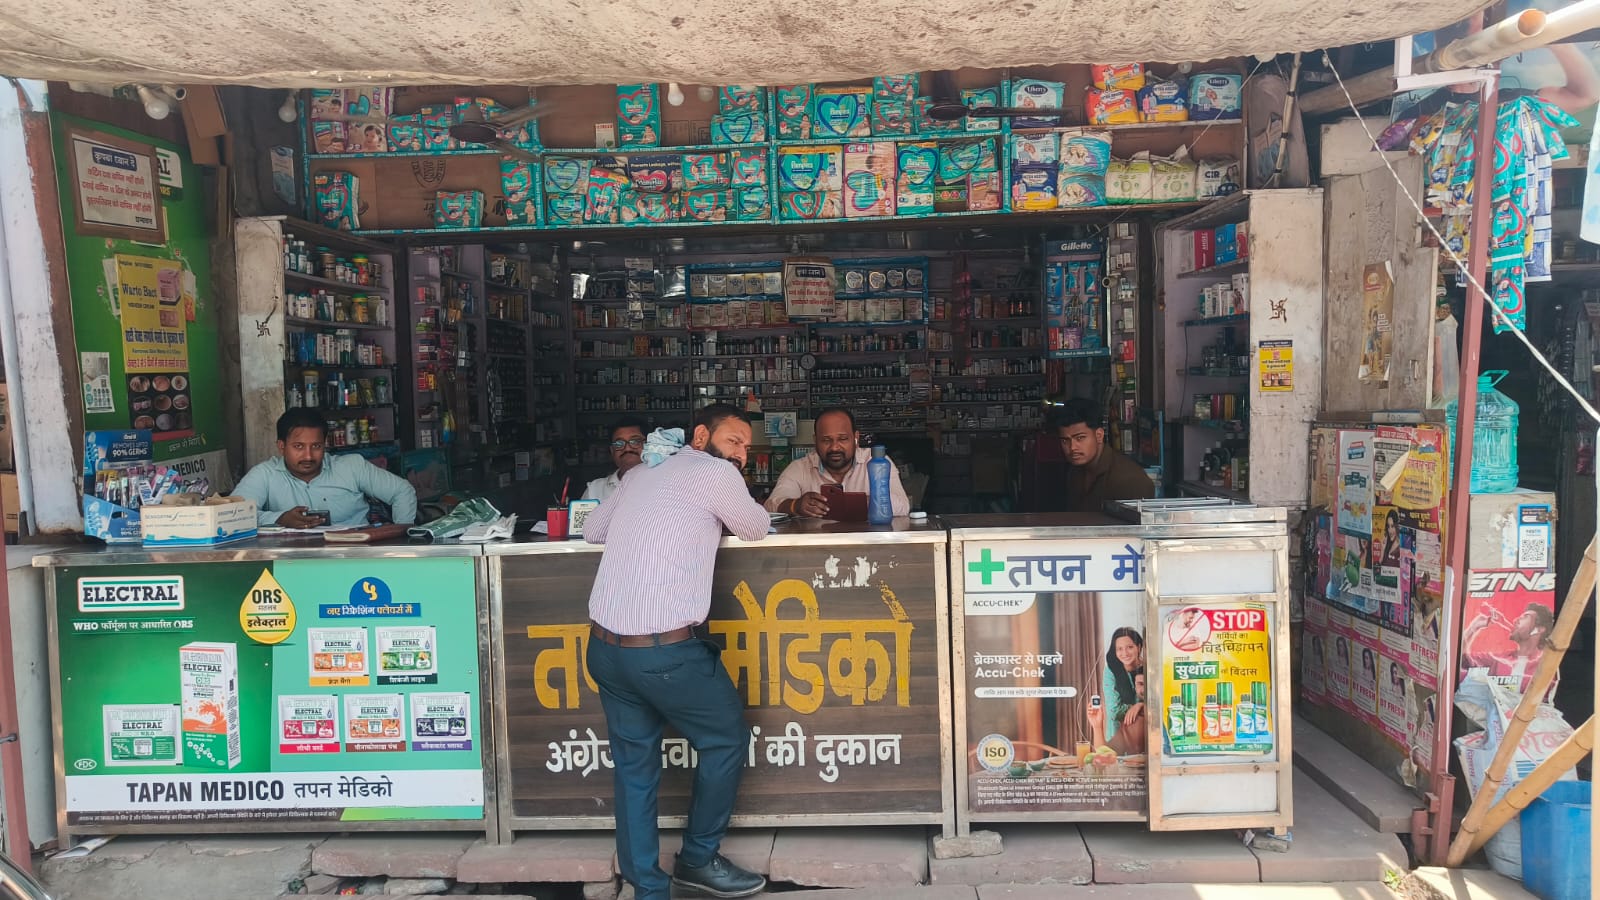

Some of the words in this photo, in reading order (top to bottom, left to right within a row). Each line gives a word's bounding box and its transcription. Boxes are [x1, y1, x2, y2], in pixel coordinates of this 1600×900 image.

[1061, 242, 1092, 251] Gillette
[1007, 555, 1092, 588] तपन
[1468, 572, 1556, 591] STING
[82, 585, 179, 603] ELECTRAL
[252, 588, 282, 605] ORS
[326, 607, 341, 615] नए
[73, 620, 99, 631] WHO
[129, 621, 139, 630] पर
[141, 619, 172, 630] आधारित
[174, 618, 194, 630] ORS
[1213, 611, 1261, 630] STOP
[973, 654, 1021, 666] ब्रेकफास्ट
[1024, 652, 1034, 664] से
[1036, 651, 1063, 665] पहले
[184, 664, 221, 672] ELECTRAL
[974, 667, 1046, 678] Accu-Chek
[1175, 662, 1217, 680] सुथॉल
[766, 722, 805, 767] की
[814, 733, 901, 783] दुकान
[985, 747, 1007, 758] ISO
[78, 761, 93, 769] FDC
[127, 782, 192, 802] TAPAN
[200, 780, 285, 801] MEDICO
[293, 783, 332, 799] तपन
[337, 774, 393, 799] मेडिको
